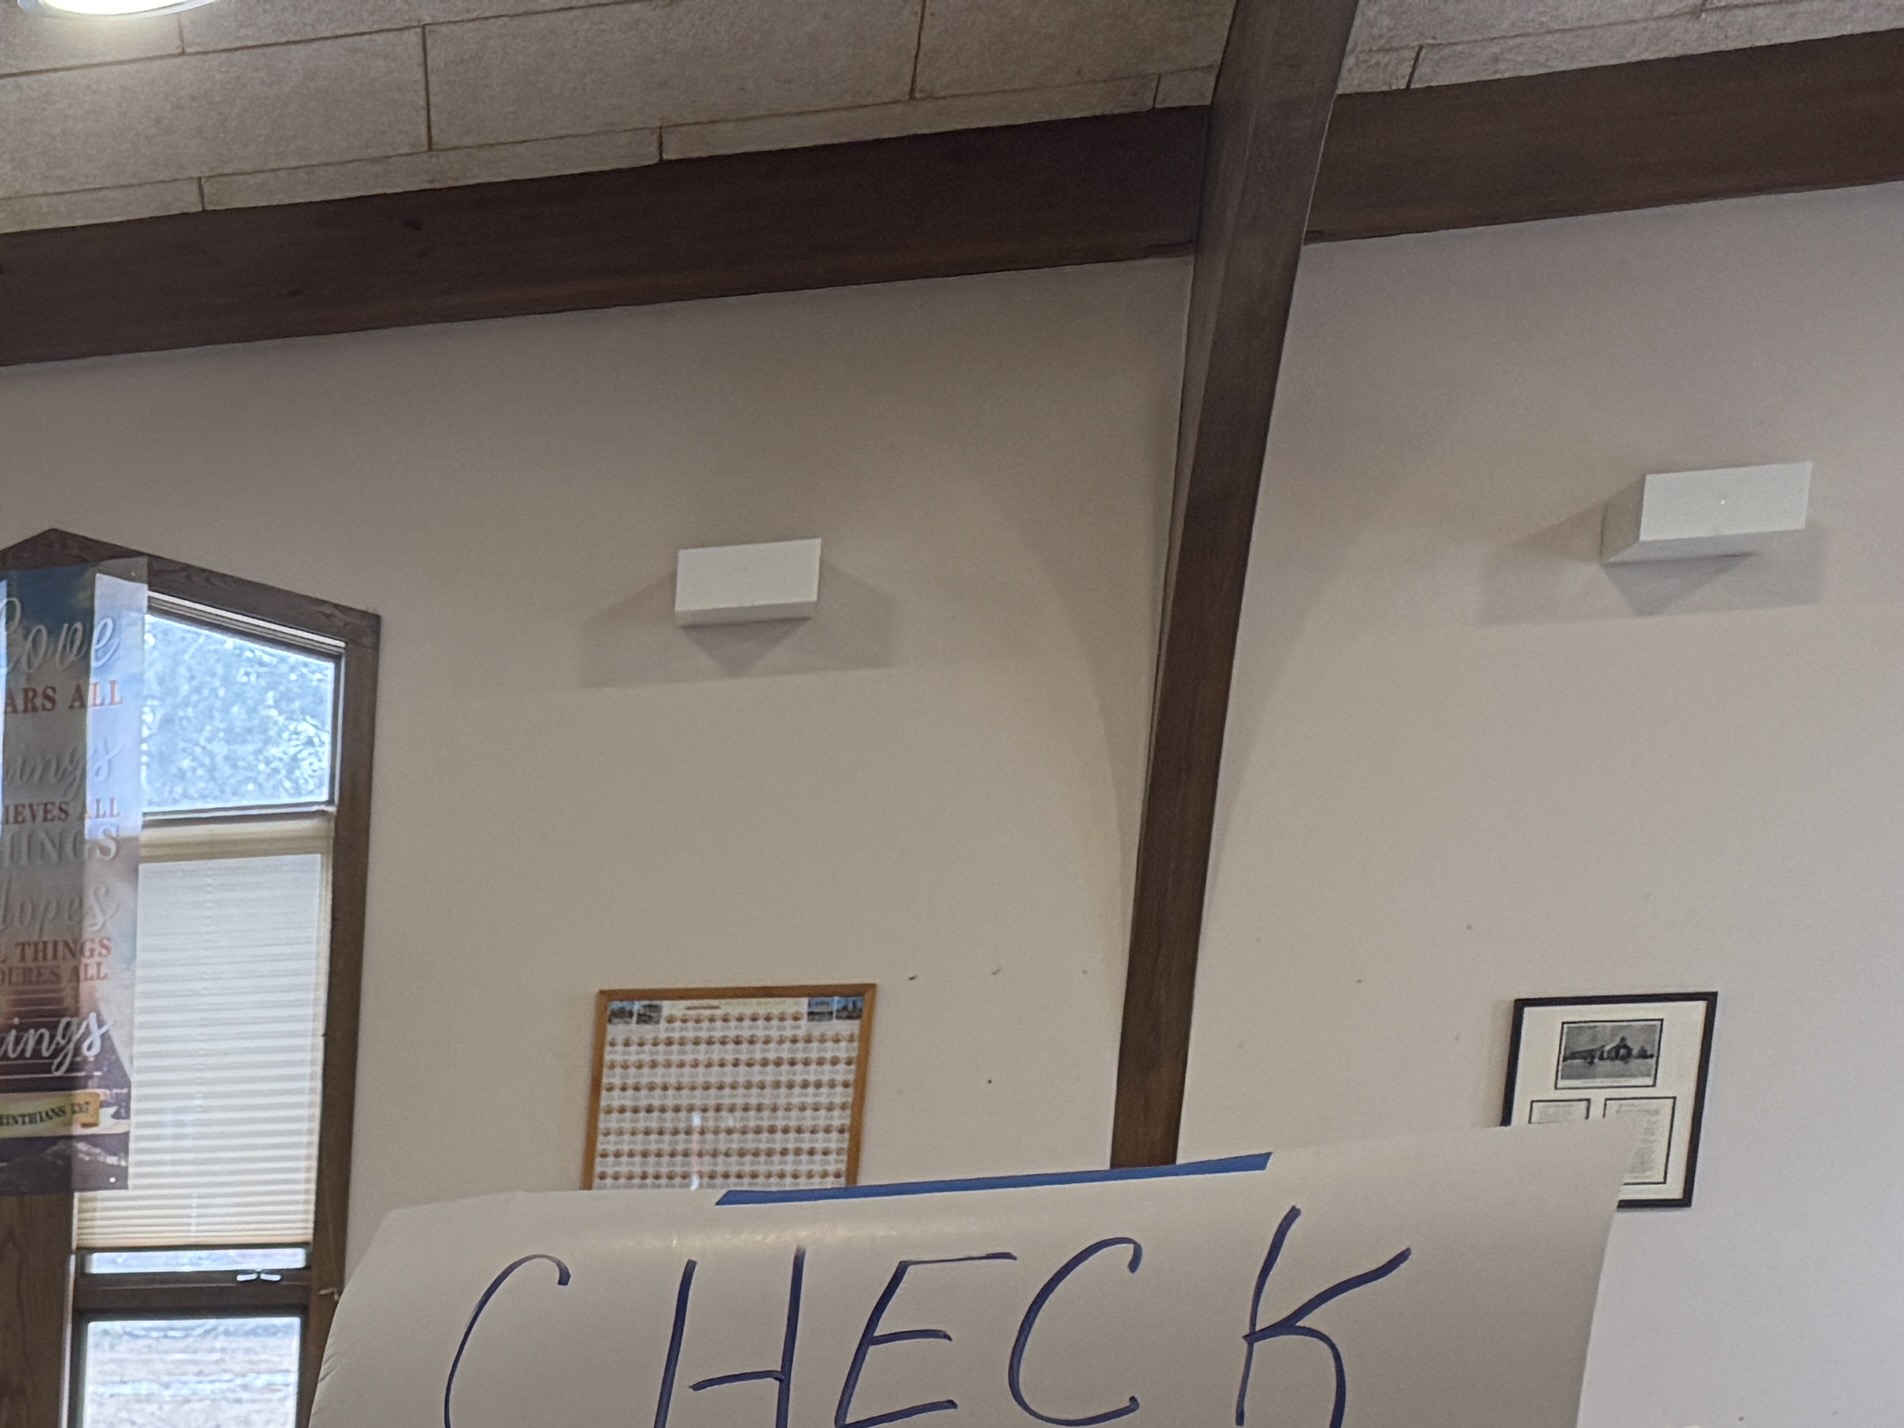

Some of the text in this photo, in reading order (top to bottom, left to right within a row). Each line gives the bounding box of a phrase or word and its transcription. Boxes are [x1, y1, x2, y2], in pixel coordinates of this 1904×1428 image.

[66, 681, 124, 709] ALL
[77, 797, 121, 821] ALL
[15, 937, 112, 965] THINGS
[68, 961, 109, 983] ALL
